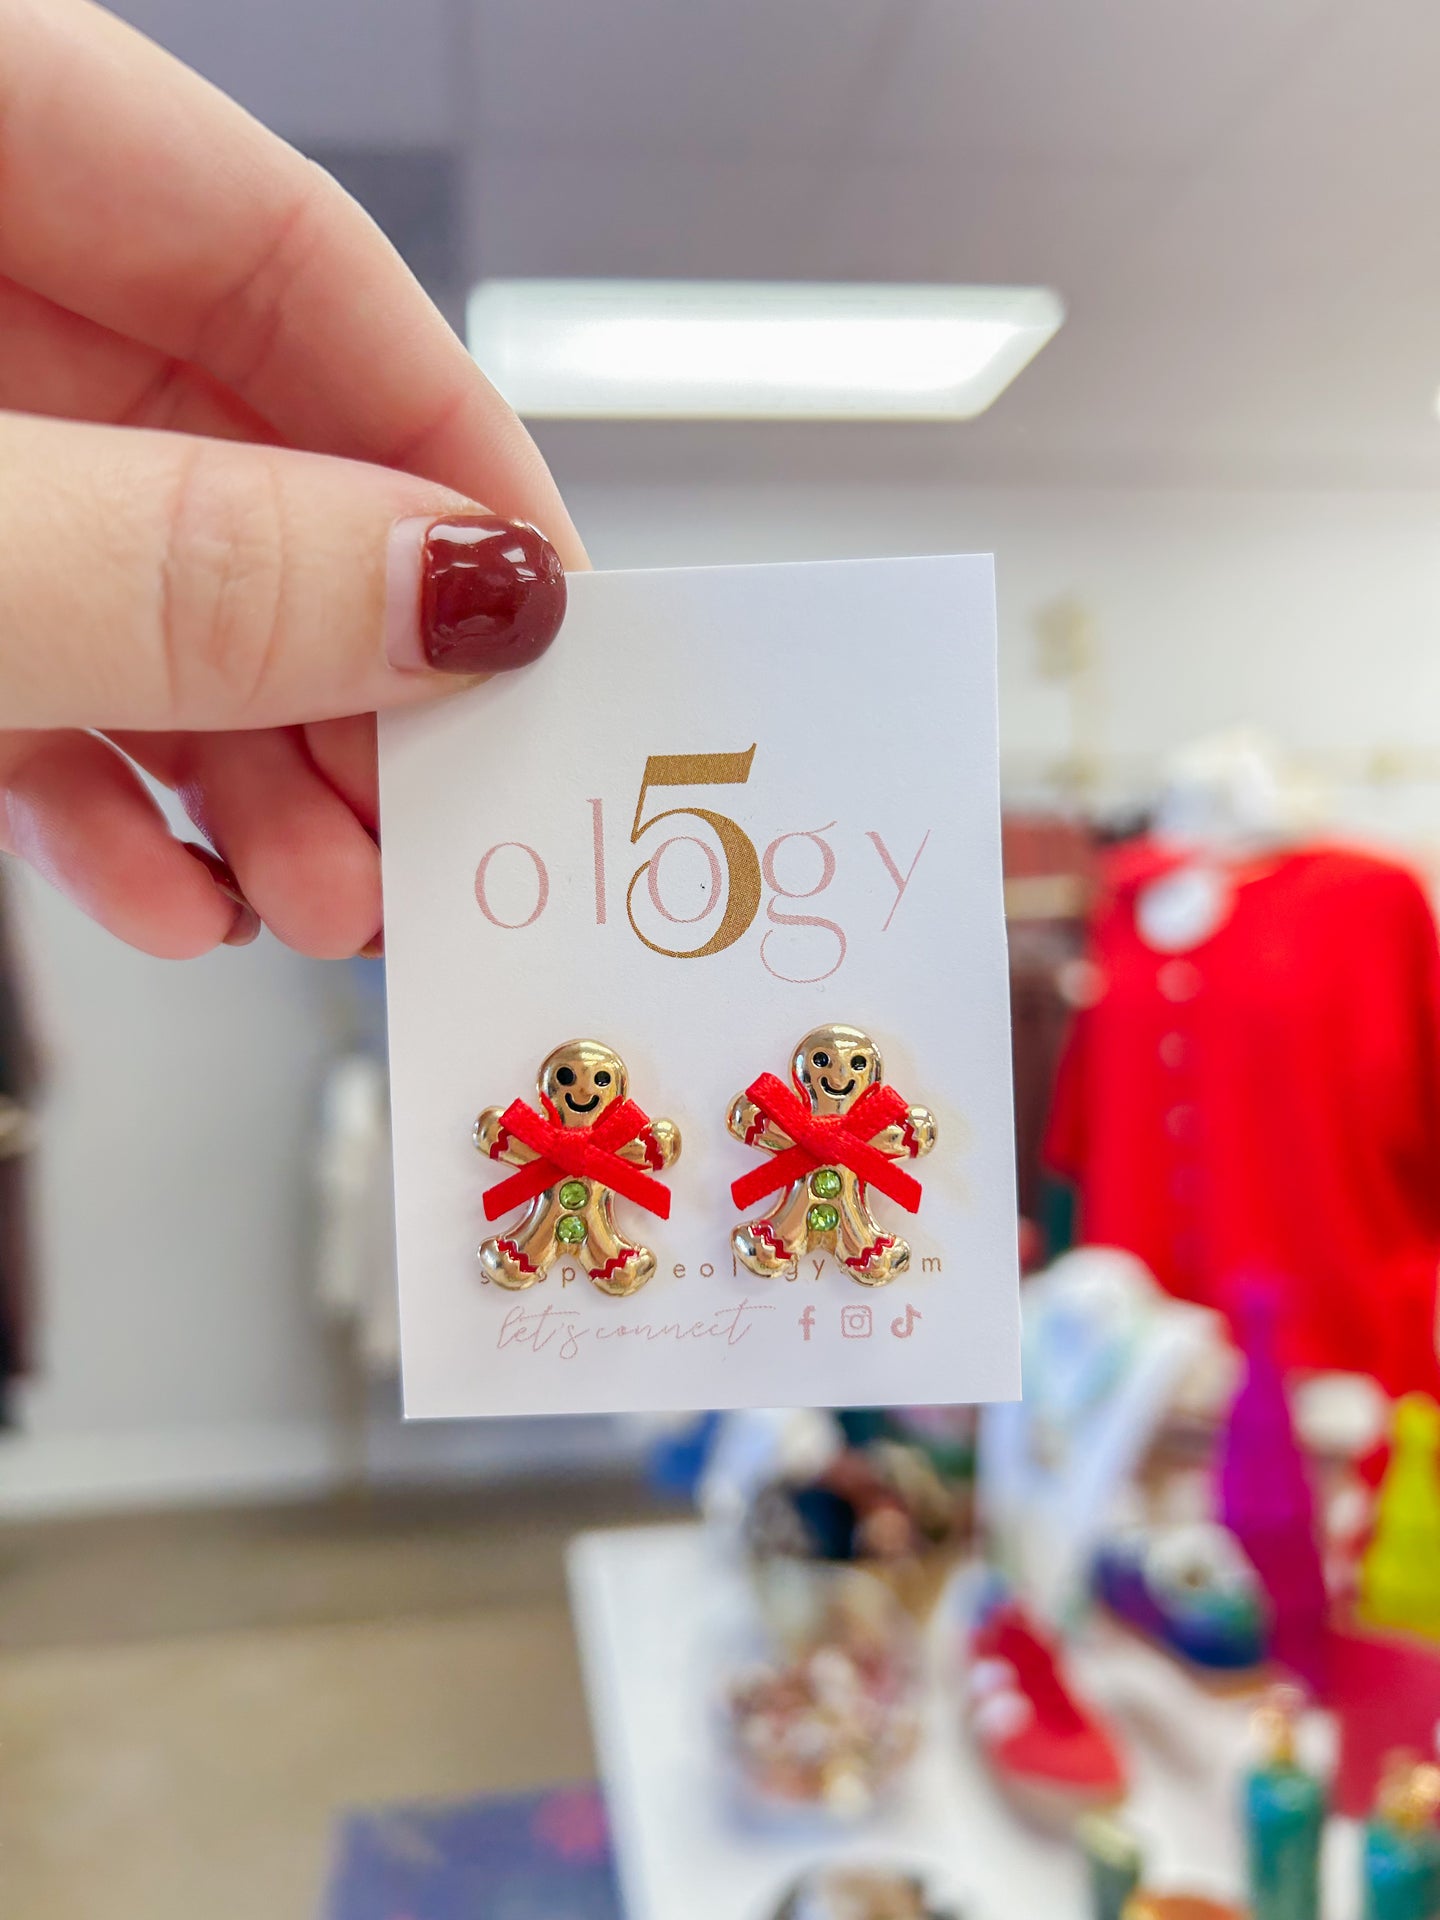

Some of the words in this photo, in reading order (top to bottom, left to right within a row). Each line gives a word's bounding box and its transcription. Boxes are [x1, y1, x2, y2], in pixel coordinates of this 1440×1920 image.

[475, 797, 930, 984] ology
[626, 743, 762, 959] 5
[594, 1297, 777, 1345] connect
